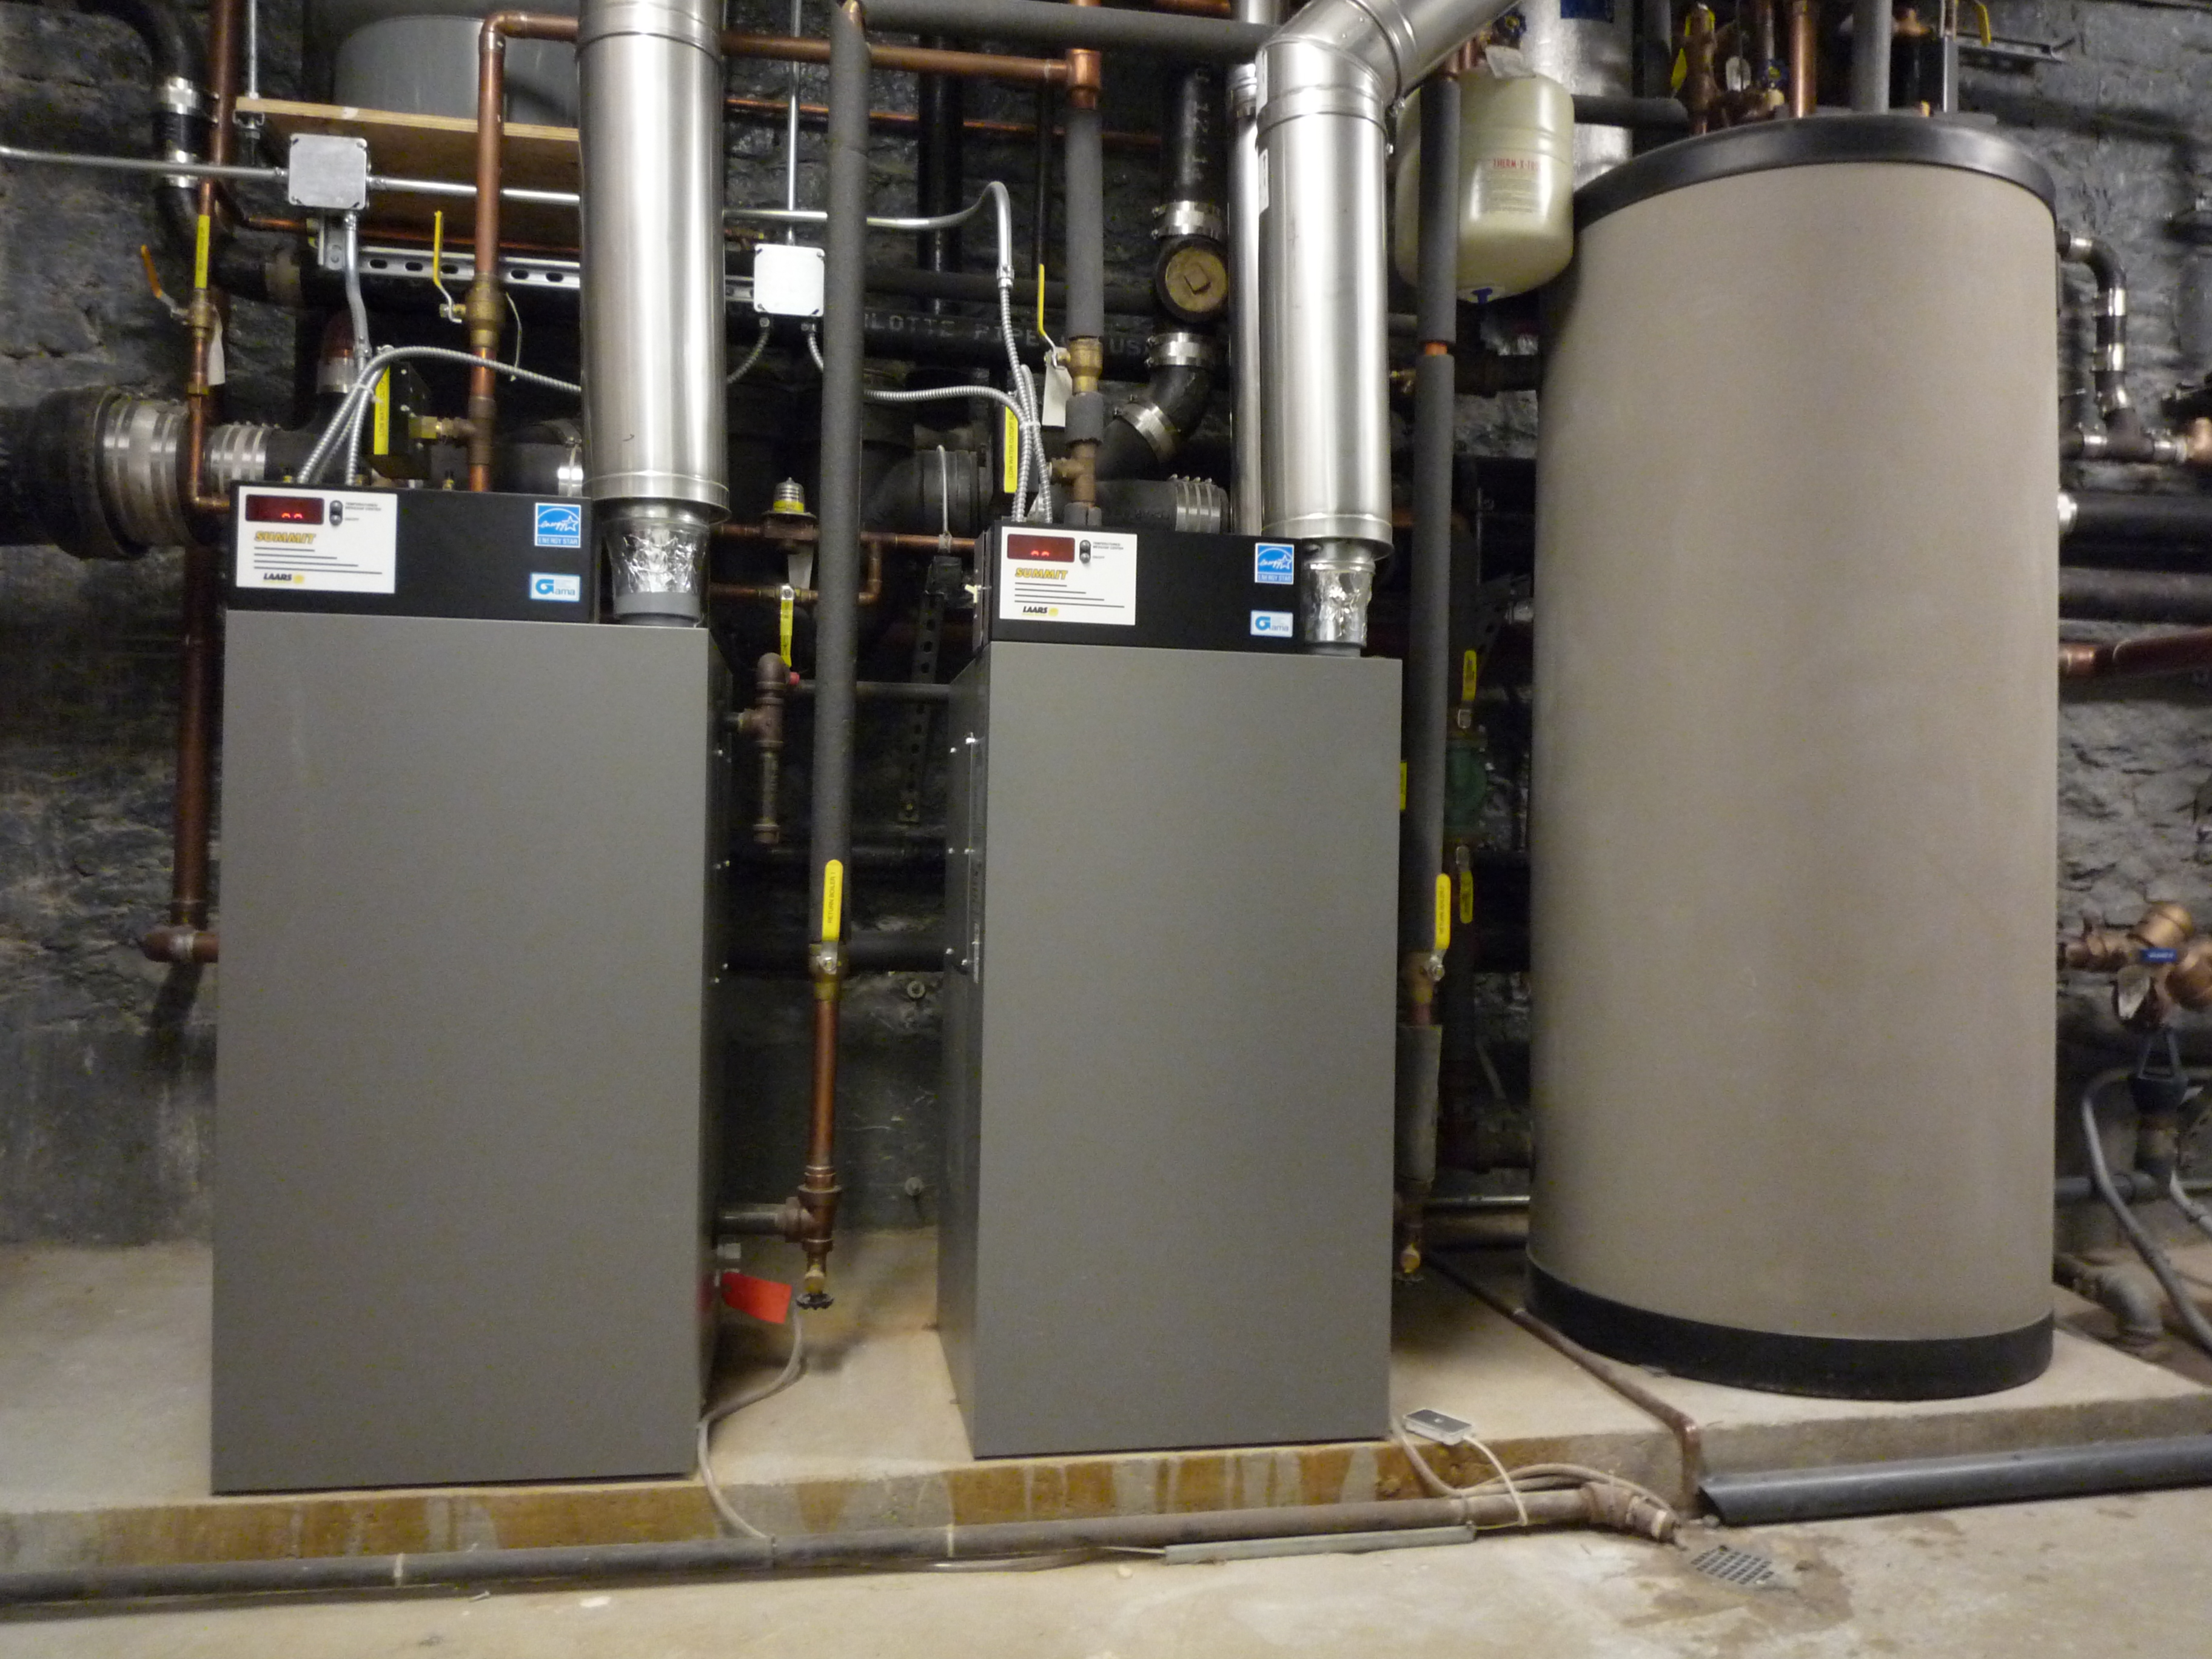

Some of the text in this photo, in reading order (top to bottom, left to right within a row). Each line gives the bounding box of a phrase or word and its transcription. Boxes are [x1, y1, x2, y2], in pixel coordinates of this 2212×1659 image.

[864, 312, 955, 337] LOTTE
[255, 531, 317, 545] SUMMIT
[538, 537, 578, 546] ENERGY STAR
[263, 572, 292, 581] LAARS
[1014, 568, 1068, 580] SUMMIT
[1022, 606, 1048, 614] LAARS
